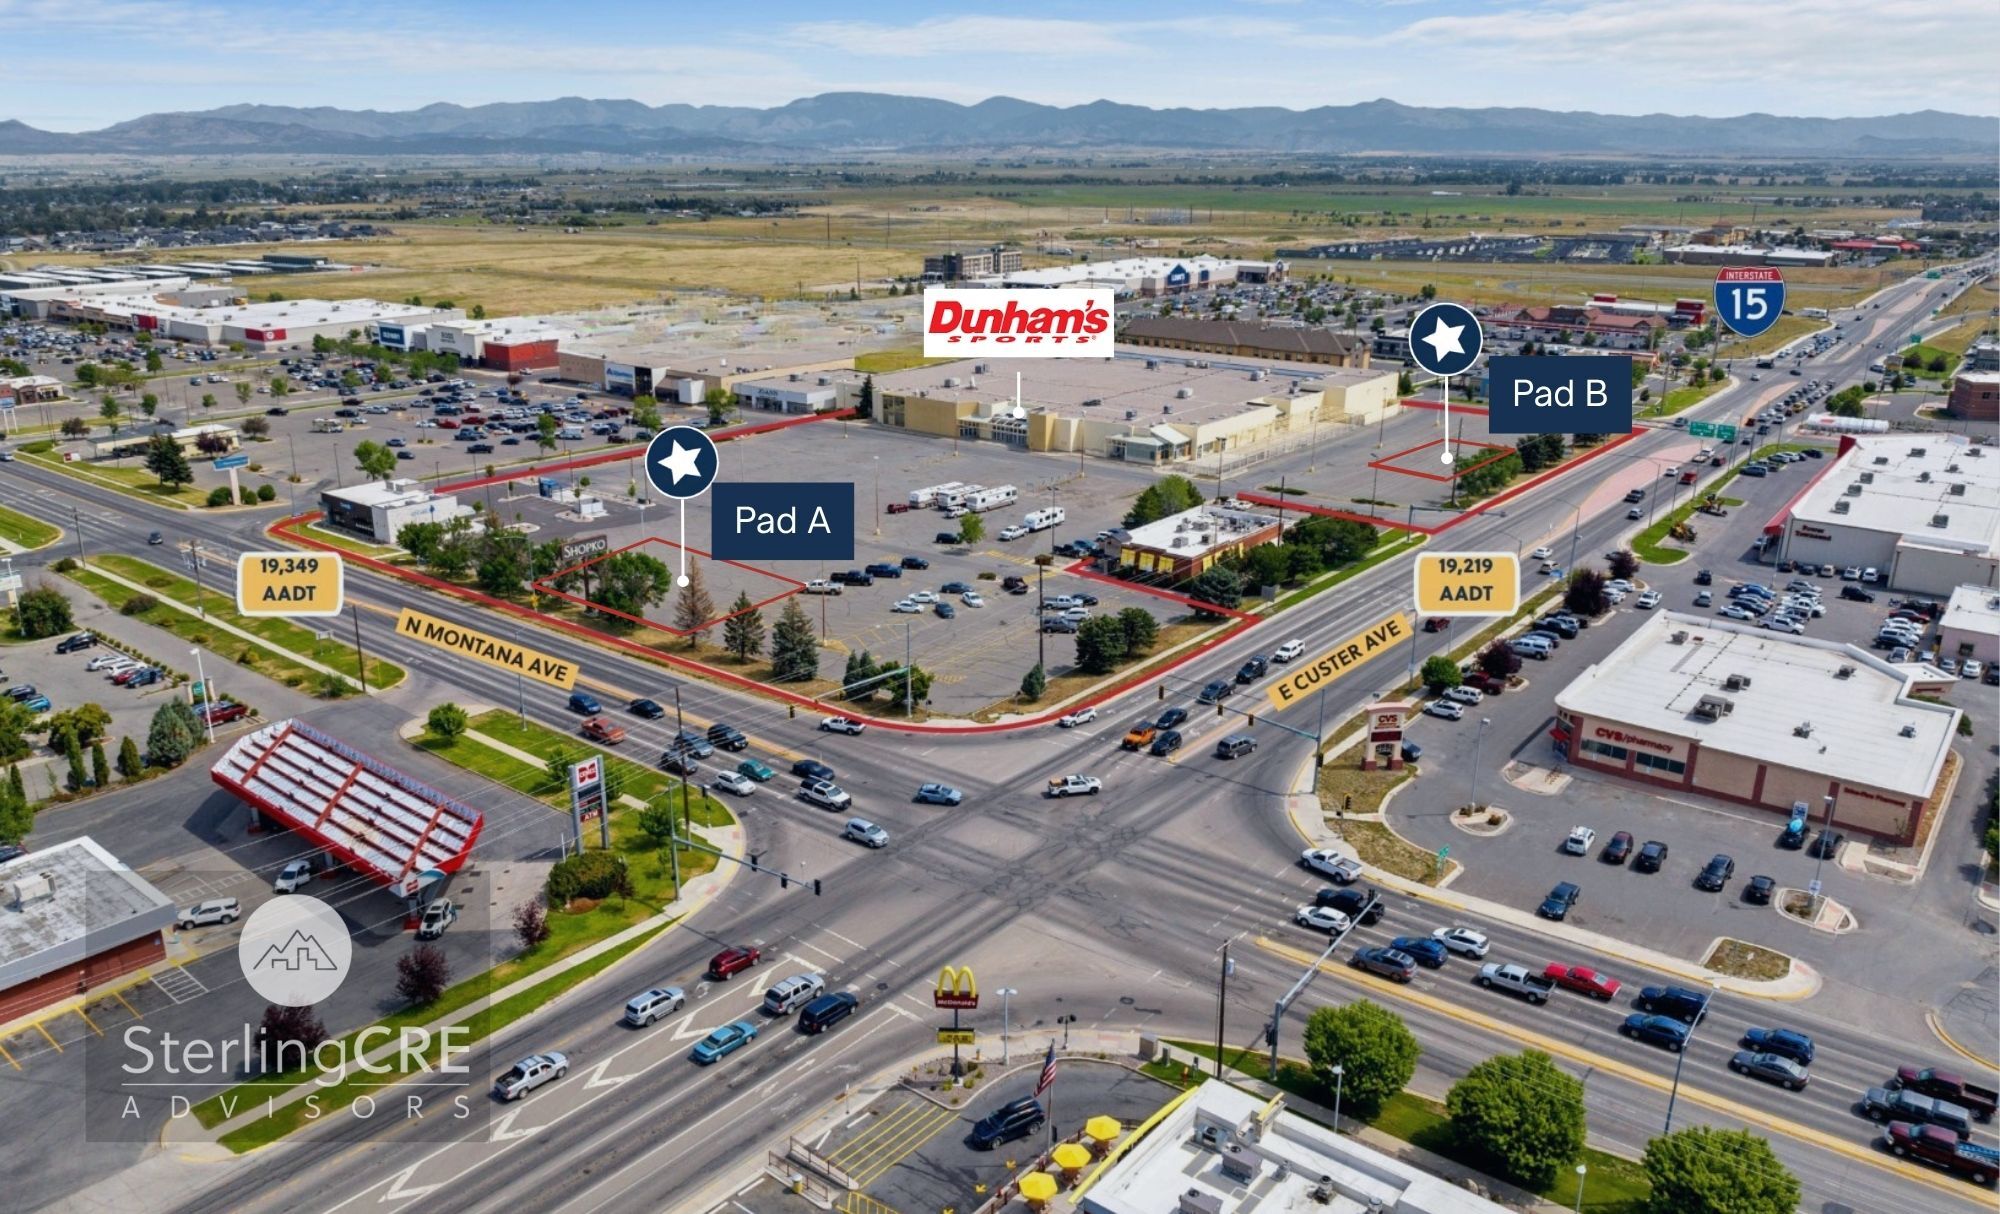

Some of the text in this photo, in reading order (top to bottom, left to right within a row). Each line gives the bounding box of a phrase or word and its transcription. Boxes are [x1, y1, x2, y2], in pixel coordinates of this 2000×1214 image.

[563, 539, 606, 559] SHOPKO
[1378, 714, 1398, 723] CVS
[584, 809, 599, 821] ATM
